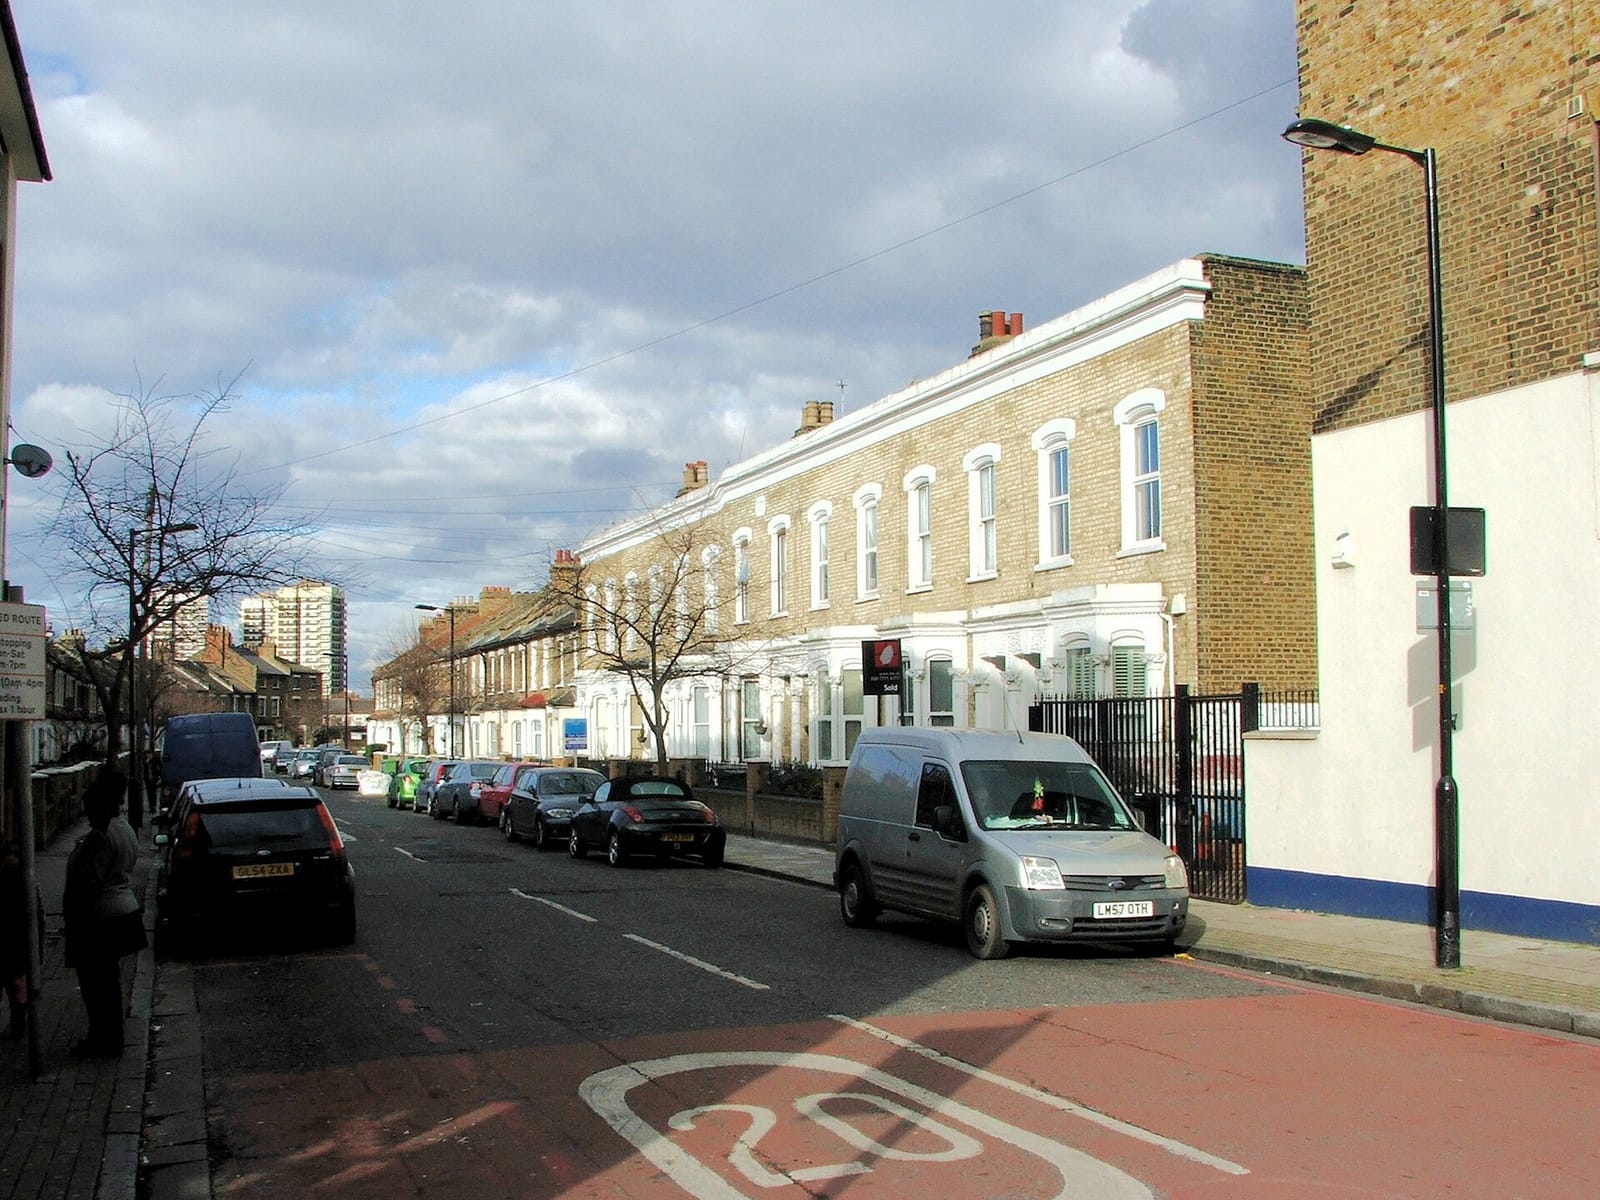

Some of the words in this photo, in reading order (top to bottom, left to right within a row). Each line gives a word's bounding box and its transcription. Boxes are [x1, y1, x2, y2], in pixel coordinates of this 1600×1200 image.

[12, 614, 41, 625] ROUTE
[883, 683, 898, 692] Sold
[17, 705, 35, 714] hour
[1098, 904, 1124, 916] LM57
[668, 1092, 984, 1189] 20
